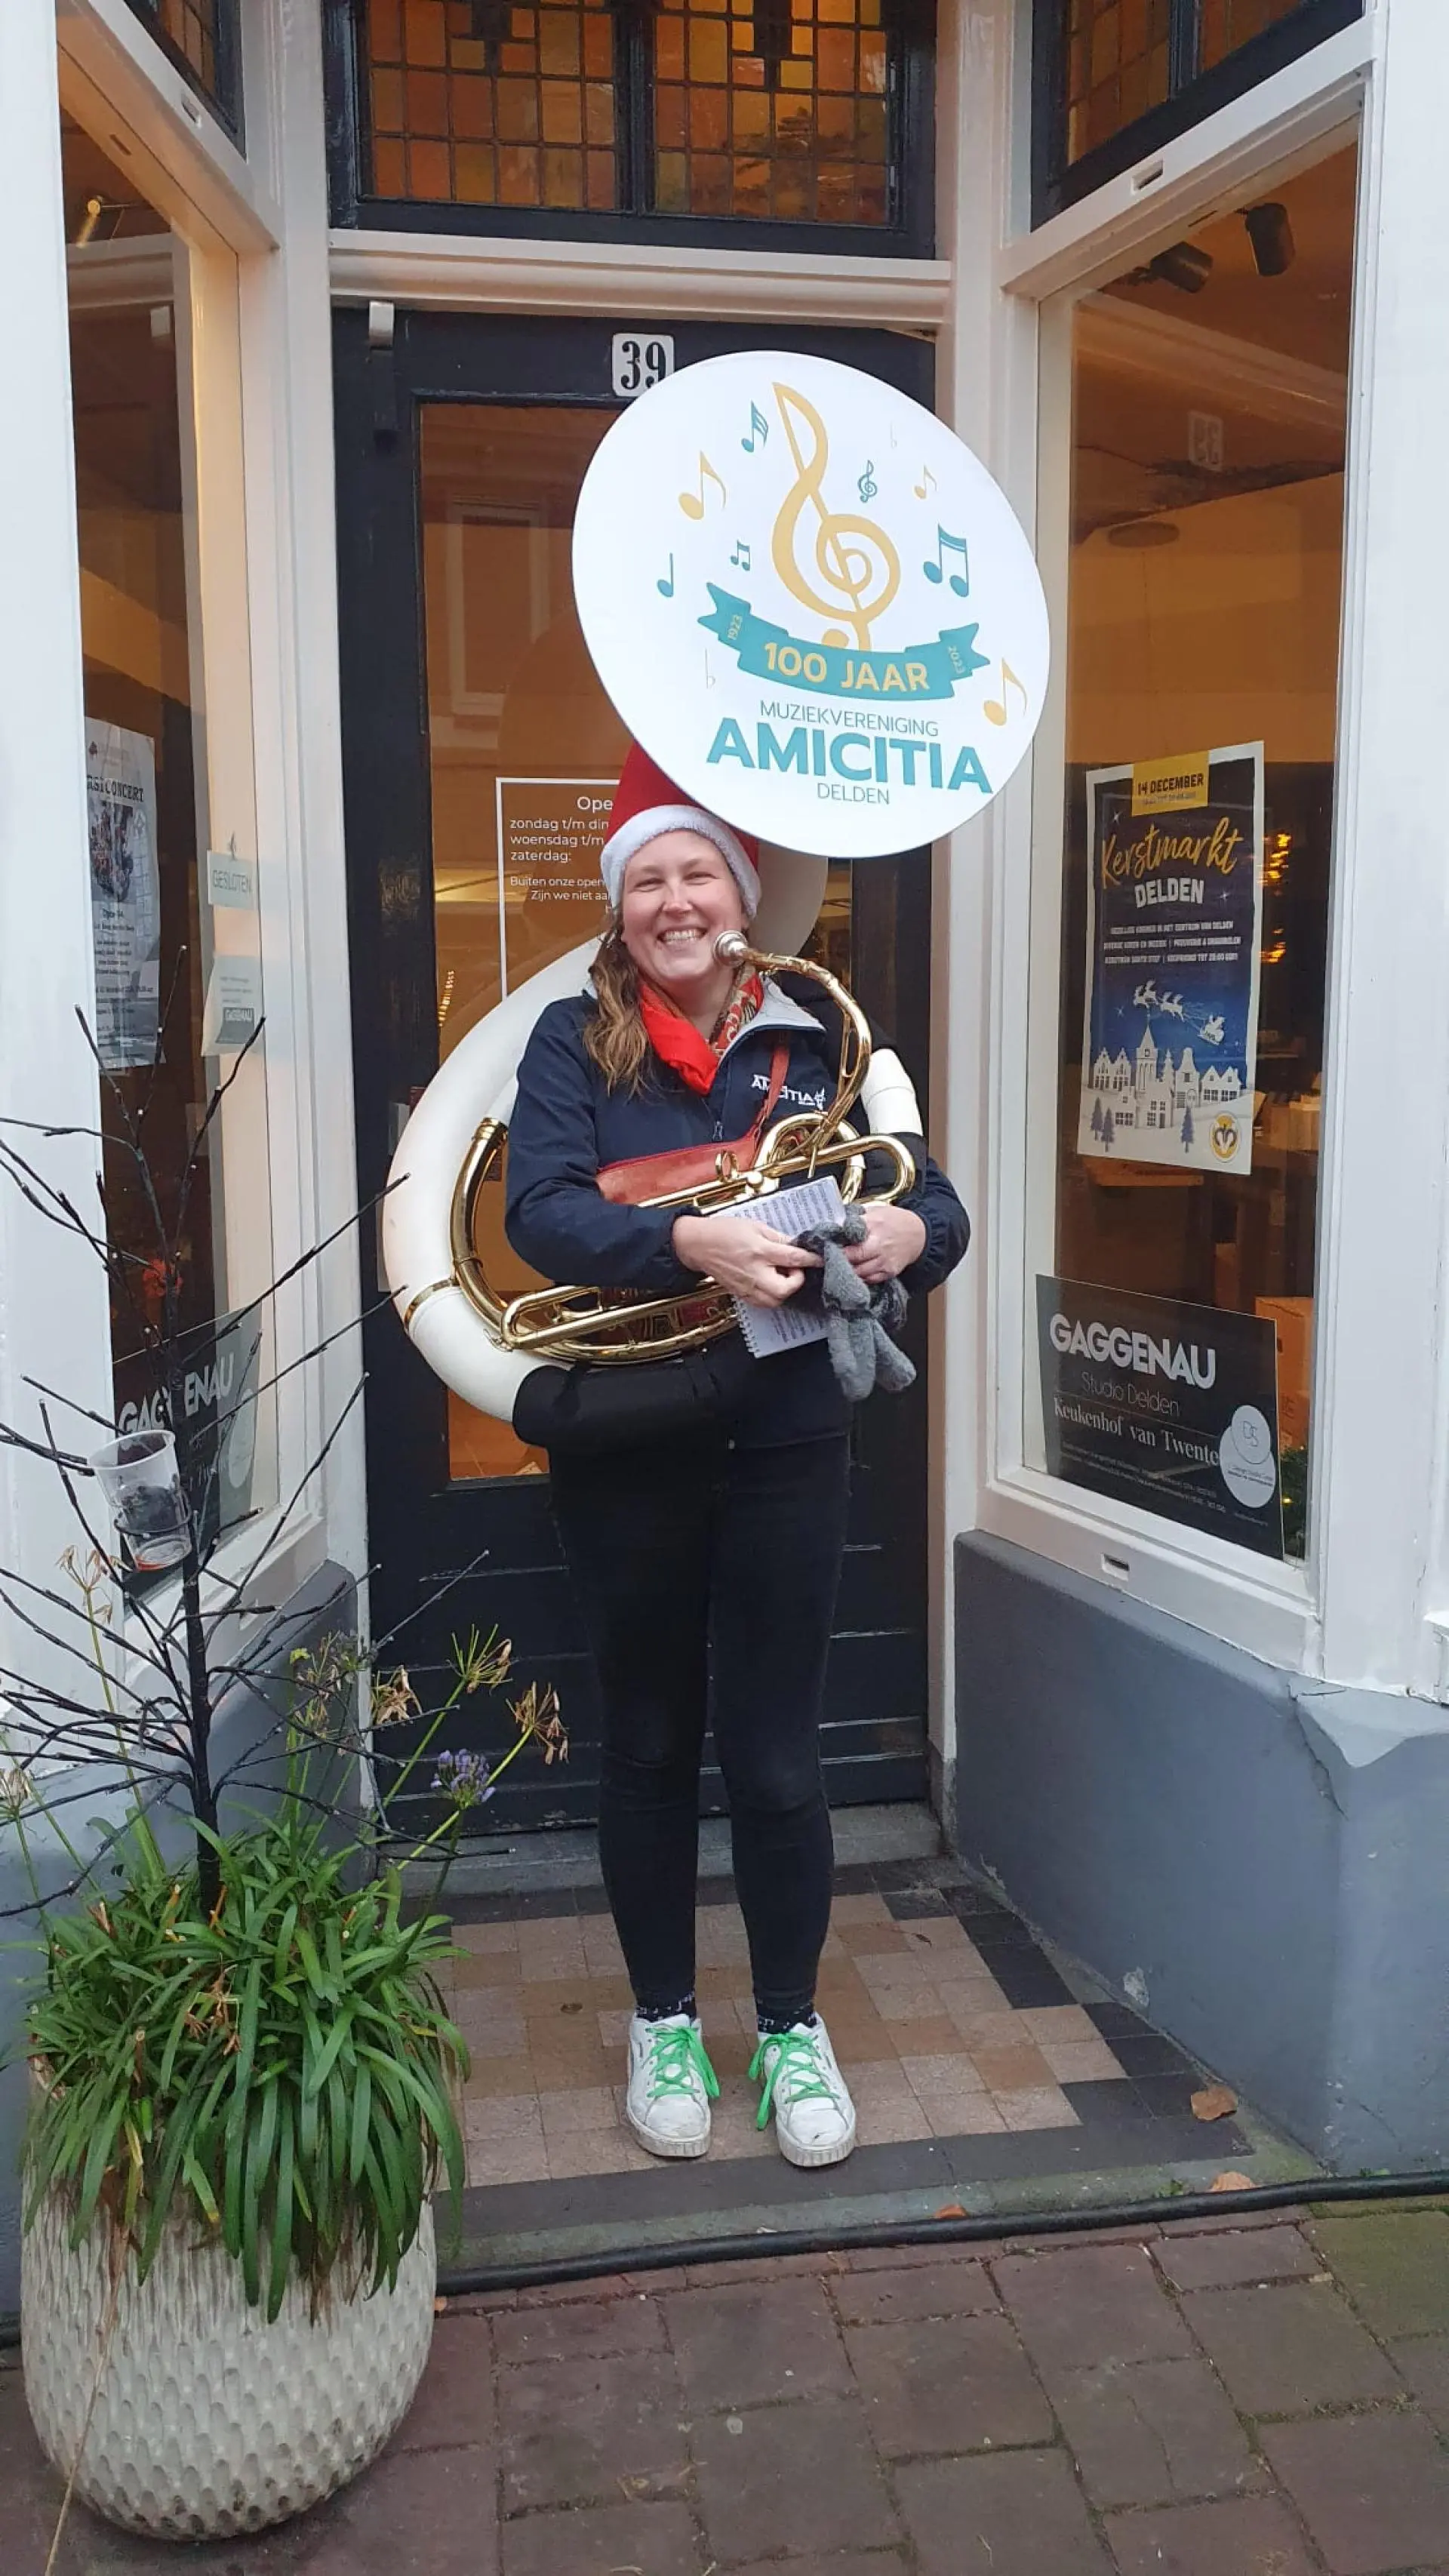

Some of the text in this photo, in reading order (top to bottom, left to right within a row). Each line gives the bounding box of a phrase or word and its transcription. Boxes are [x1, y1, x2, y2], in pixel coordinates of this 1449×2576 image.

[620, 340, 667, 389] 39
[764, 641, 930, 692] 100 JAAR
[760, 699, 939, 737] MUZIEKVERENIGING
[706, 716, 993, 794] AMICITIA
[817, 783, 890, 805] DELDEN
[1137, 773, 1204, 796] 14 DECEMBER
[577, 796, 613, 813] Ope
[509, 817, 609, 831] zondag t/m din
[510, 834, 604, 848] woensdag t/m
[510, 850, 571, 863] zaterdag:
[1101, 816, 1244, 891] Kerstmarkt
[510, 876, 546, 887] Buiten
[577, 879, 605, 888] open
[531, 890, 610, 902] Zijn we niet aa
[1134, 877, 1204, 909] DELDEN
[1050, 1313, 1216, 1390] GAGGENAU
[118, 1353, 234, 1445] GAGENAU
[1081, 1371, 1180, 1417] Studio Delden
[1054, 1397, 1219, 1467] Keukenhof van Twente
